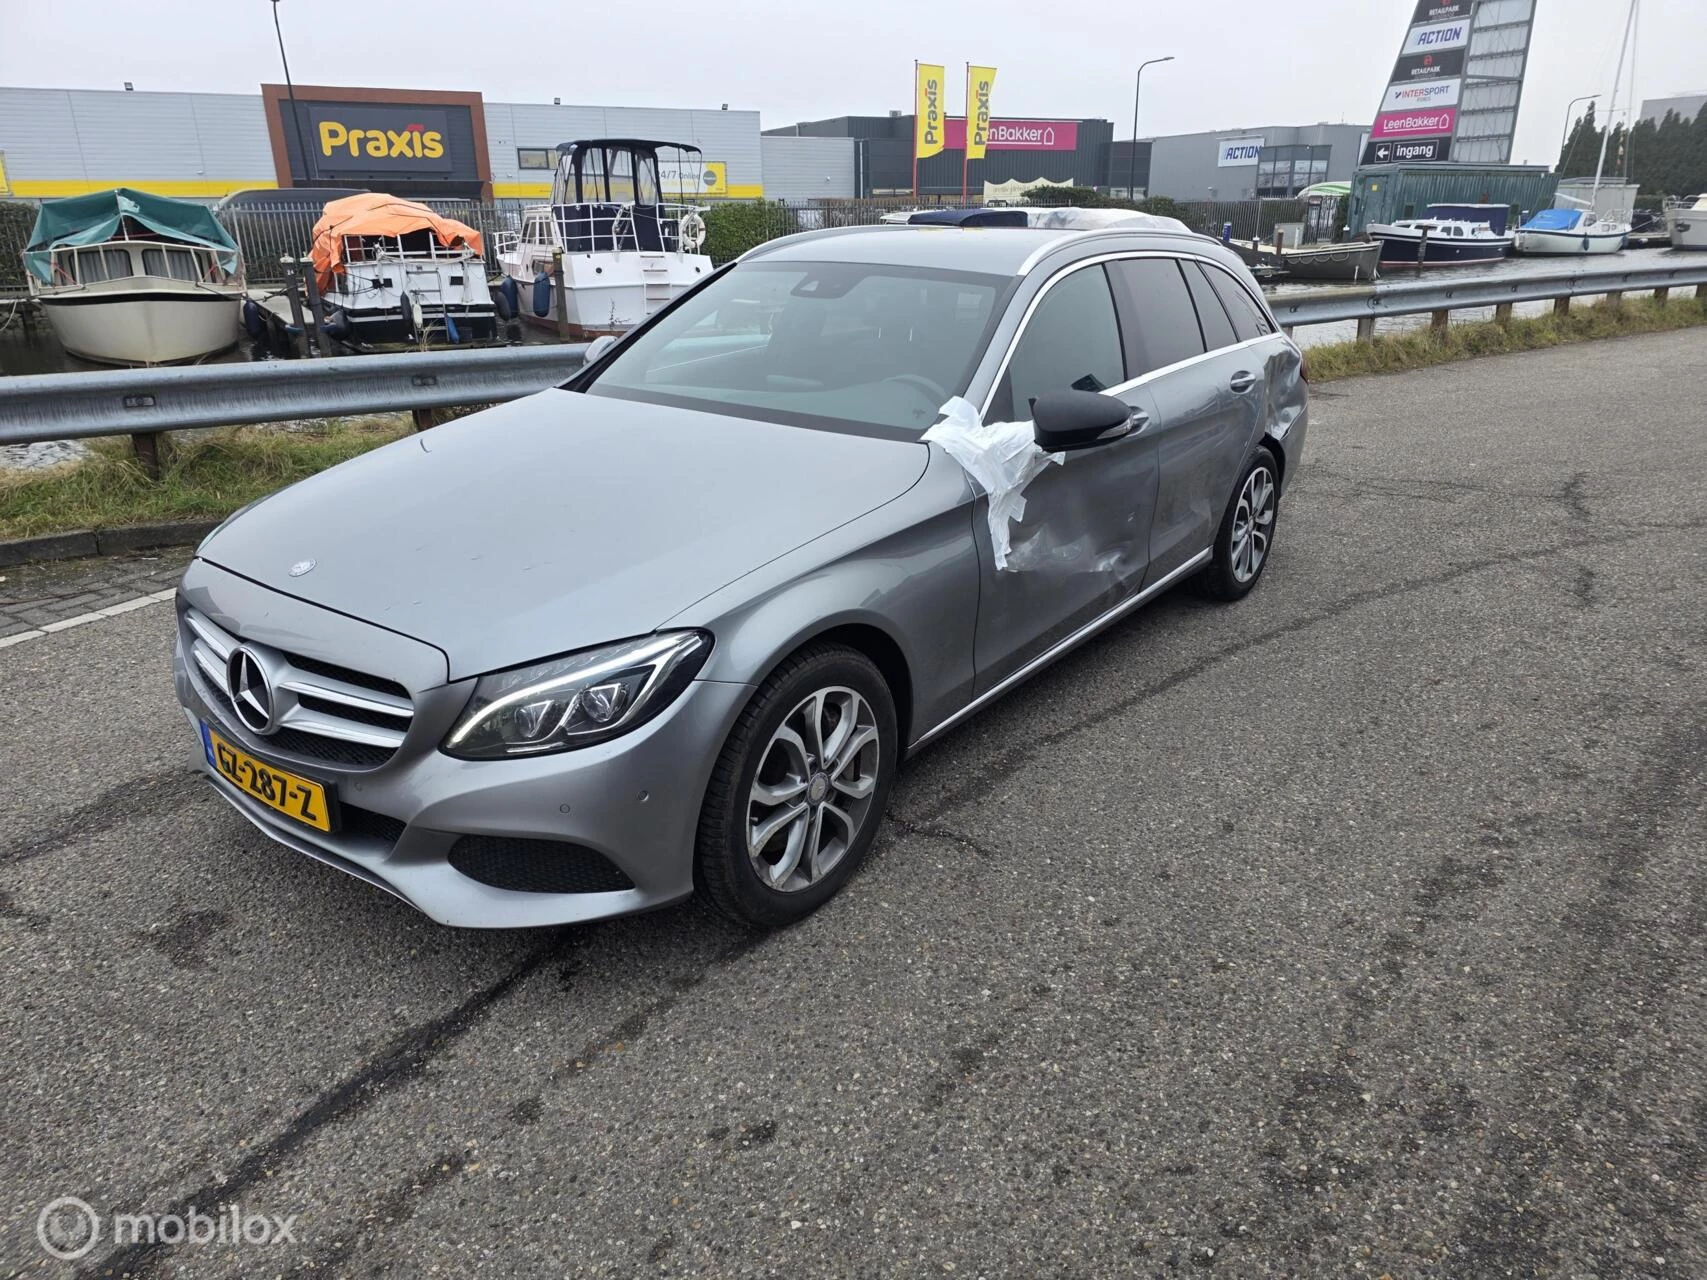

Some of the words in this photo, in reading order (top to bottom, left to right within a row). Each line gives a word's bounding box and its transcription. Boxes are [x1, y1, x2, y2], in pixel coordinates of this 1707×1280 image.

[1428, 4, 1460, 16] RETAILPARK
[1417, 27, 1462, 46] ACTION
[1411, 65, 1441, 75] RETAILPARK
[1402, 85, 1450, 98] INTERSPORT
[924, 79, 938, 145] Praxis
[973, 80, 989, 145] Praxis
[1384, 116, 1439, 130] LeenBakker
[319, 121, 444, 158] Praxis
[987, 126, 1043, 141] nBakker
[1397, 145, 1433, 158] ingang
[660, 170, 677, 179] 4/7
[217, 743, 316, 821] GZ-287-Z
